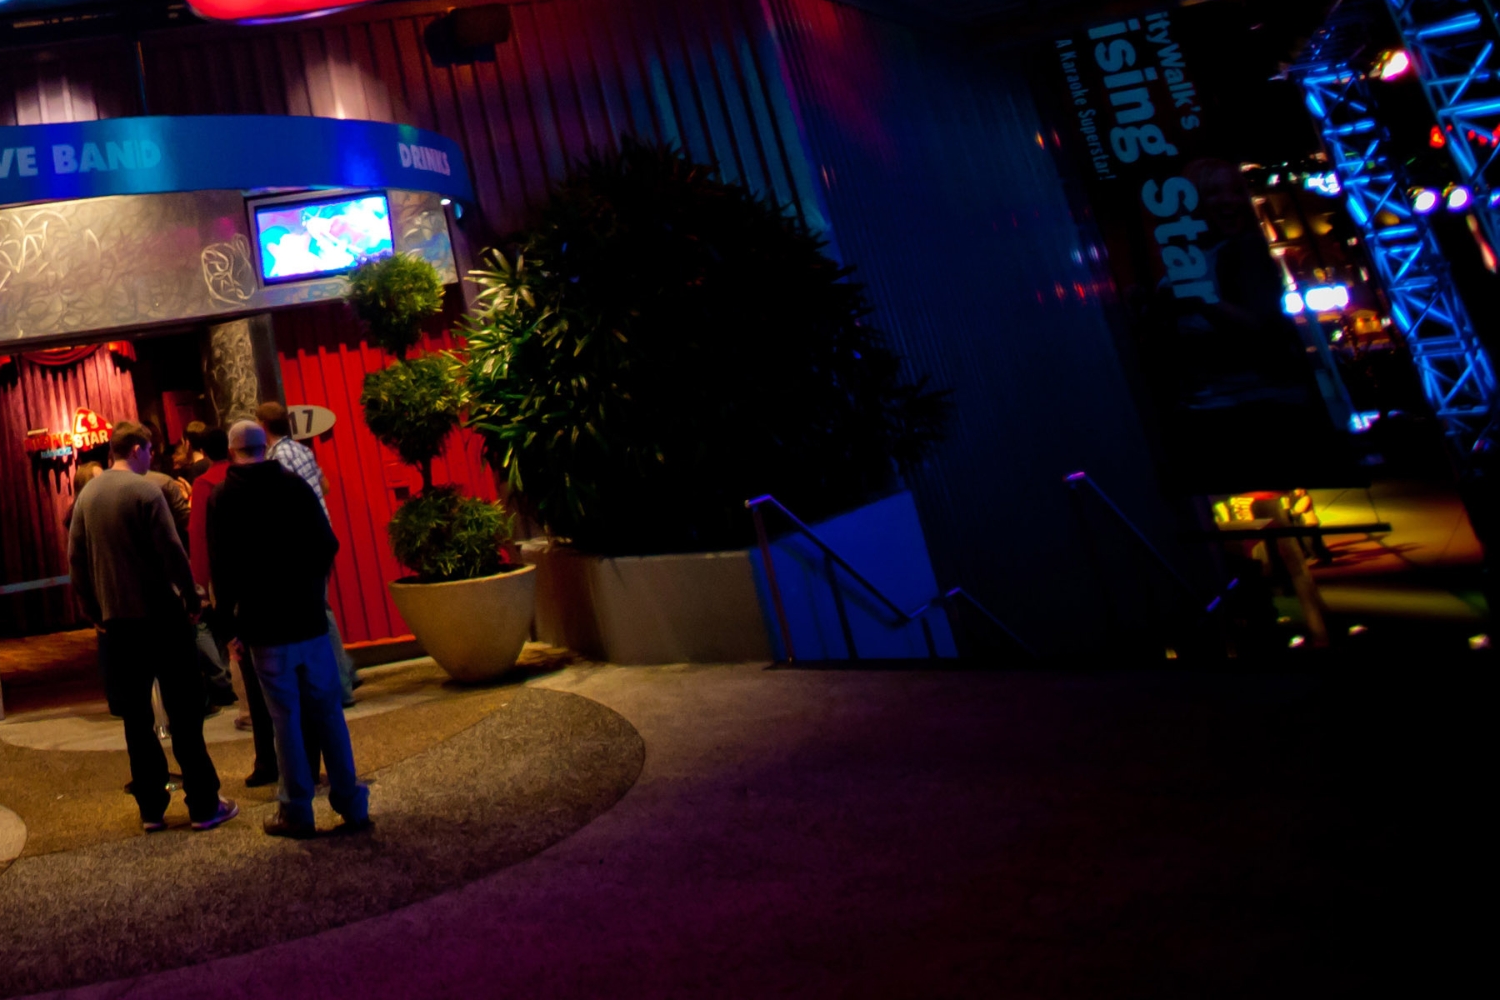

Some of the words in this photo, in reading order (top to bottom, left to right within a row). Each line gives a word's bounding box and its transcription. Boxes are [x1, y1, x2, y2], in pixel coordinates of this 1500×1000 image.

[1145, 10, 1202, 131] ityWalk's
[52, 140, 162, 174] BAND
[398, 142, 451, 176] DRINKS
[1087, 18, 1180, 164] ising
[1140, 175, 1221, 305] Star
